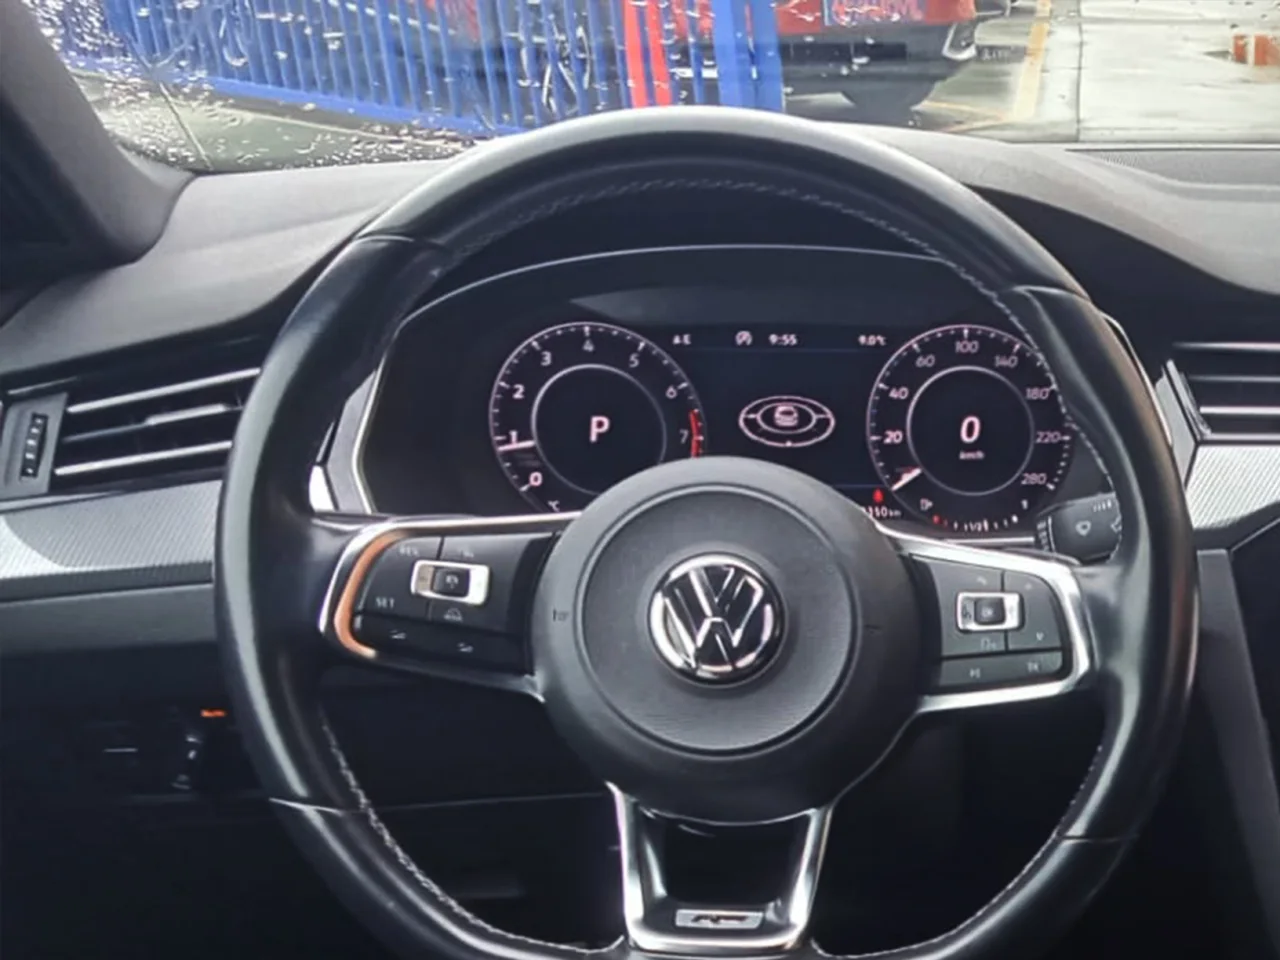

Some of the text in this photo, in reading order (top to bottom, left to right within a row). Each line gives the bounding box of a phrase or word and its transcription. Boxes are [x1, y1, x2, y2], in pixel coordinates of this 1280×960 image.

[768, 334, 797, 345] 9:55
[955, 341, 979, 353] 100
[540, 352, 552, 366] 3
[629, 353, 640, 367] 5
[916, 354, 935, 367] 60
[995, 355, 1018, 367] 140
[513, 384, 525, 399] 2
[666, 386, 677, 399] 6
[888, 387, 909, 400] 40
[1026, 388, 1050, 400] 180
[589, 416, 610, 443] P
[960, 416, 981, 443] 0
[884, 431, 903, 444] 20
[1036, 431, 1061, 443] 220
[529, 472, 542, 486] 0
[375, 596, 396, 610] SET
